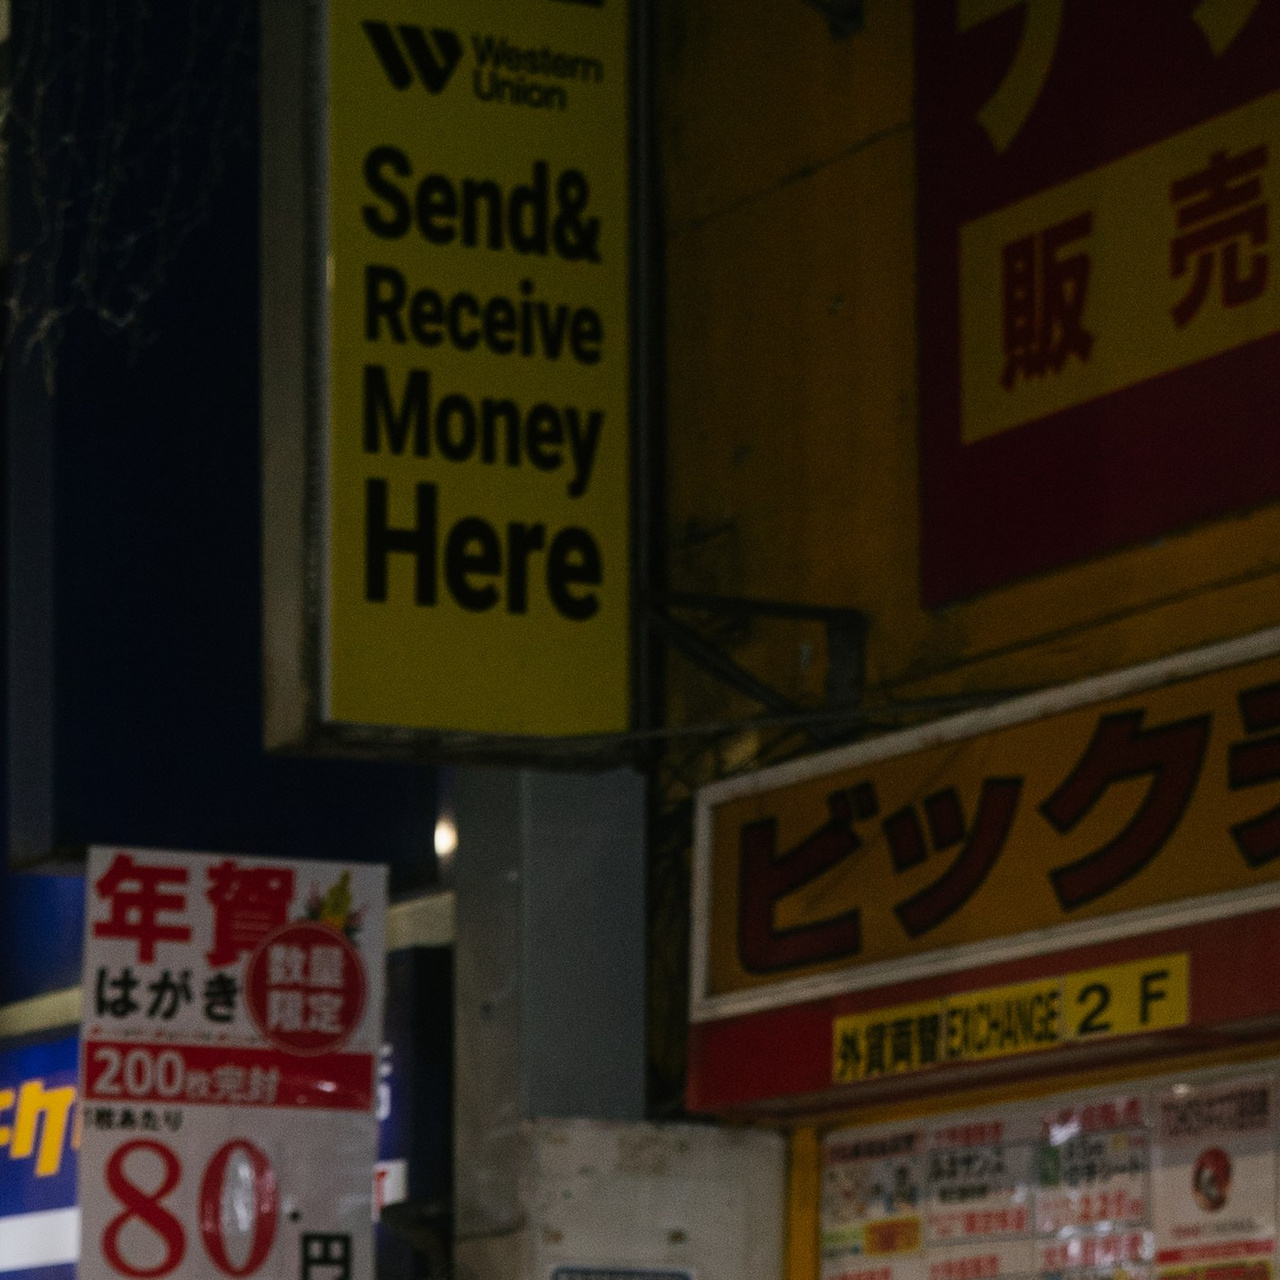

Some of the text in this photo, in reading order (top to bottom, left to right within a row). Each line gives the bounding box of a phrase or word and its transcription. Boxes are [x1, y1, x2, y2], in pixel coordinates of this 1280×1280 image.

[472, 35, 605, 82] Western
[473, 69, 567, 110] Union
[361, 144, 603, 263] Send&
[363, 265, 605, 365] Receive
[1000, 143, 1270, 393] 販売
[363, 365, 606, 498] Money
[363, 477, 605, 622] Here
[93, 854, 296, 967] 年賀
[94, 967, 240, 1023] はがき
[946, 990, 1062, 1060] EXCHANGE
[101, 1138, 280, 1280] 80
